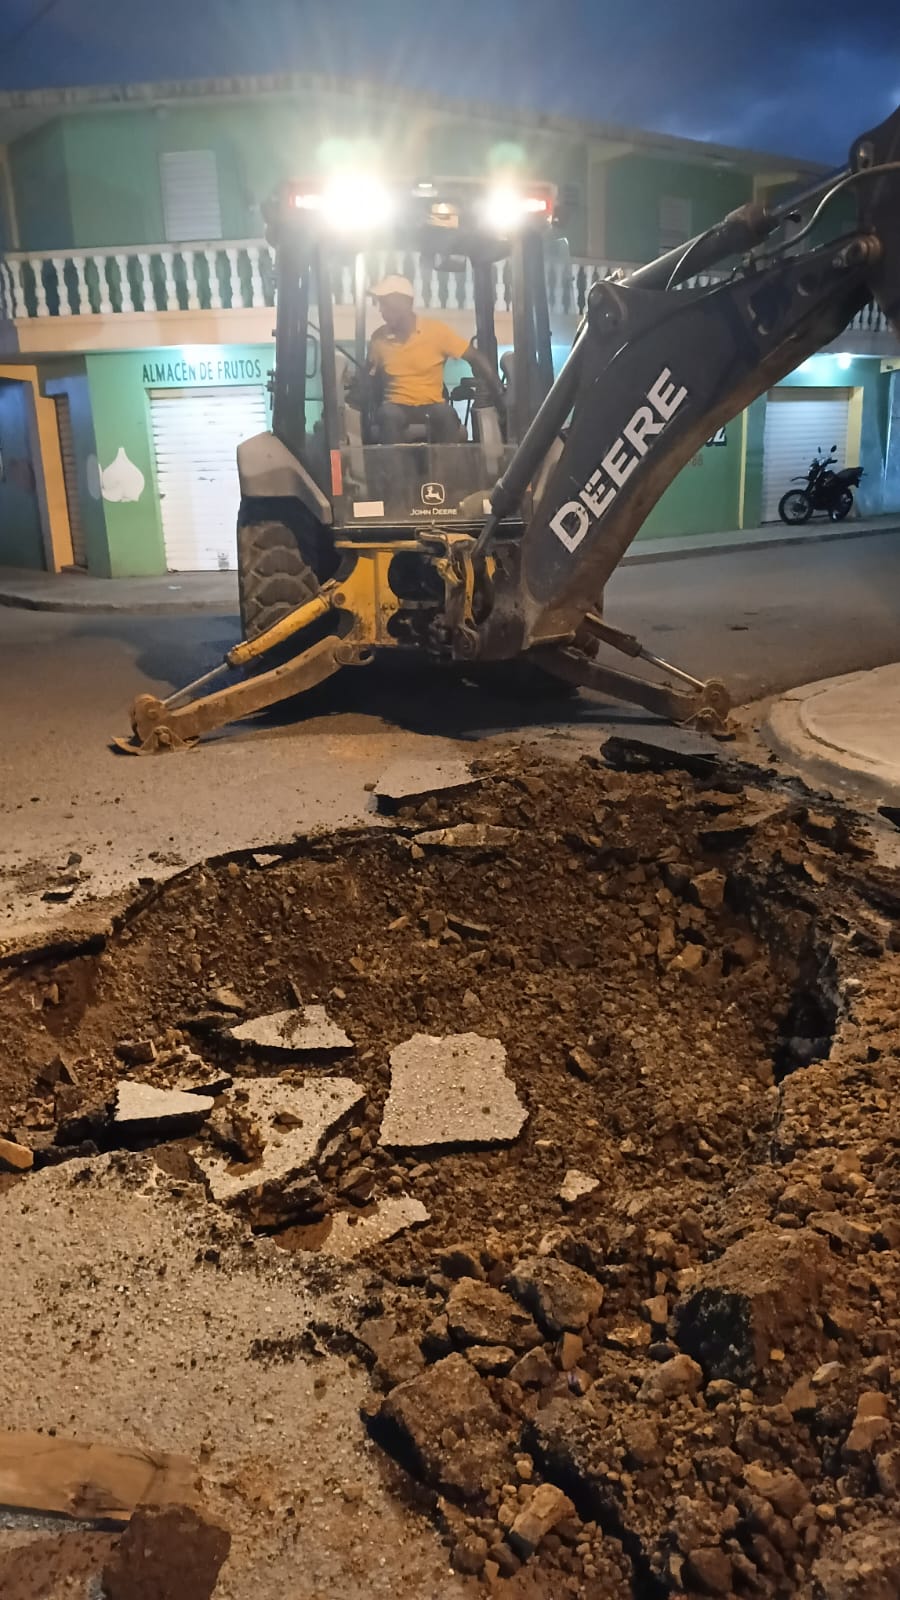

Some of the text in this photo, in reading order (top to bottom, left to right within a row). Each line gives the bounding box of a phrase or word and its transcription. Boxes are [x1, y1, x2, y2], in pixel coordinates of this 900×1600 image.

[199, 362, 214, 380] DE
[217, 359, 261, 380] FRUTOS
[549, 367, 688, 554] DEERE
[410, 507, 457, 516] JOHN DEERE
